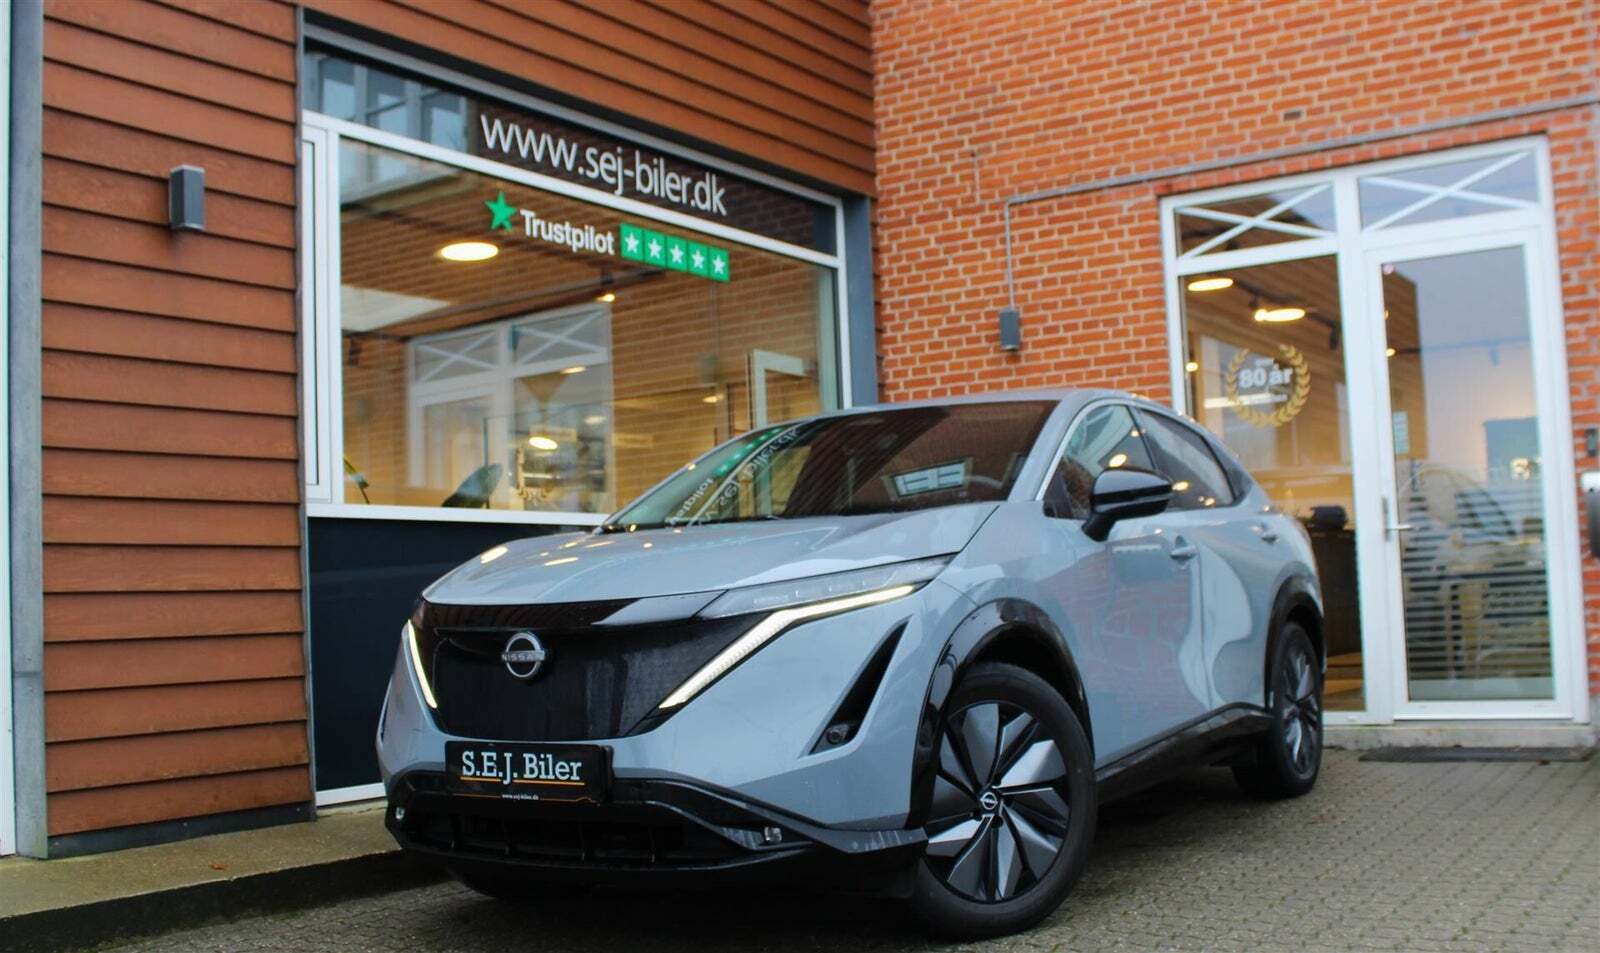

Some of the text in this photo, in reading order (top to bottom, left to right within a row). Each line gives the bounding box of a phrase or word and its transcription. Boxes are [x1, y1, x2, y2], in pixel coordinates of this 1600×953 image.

[480, 114, 728, 217] www.sej-biler.dk
[520, 208, 616, 256] Trustpilot
[462, 750, 582, 785] S.E.J. Biler
